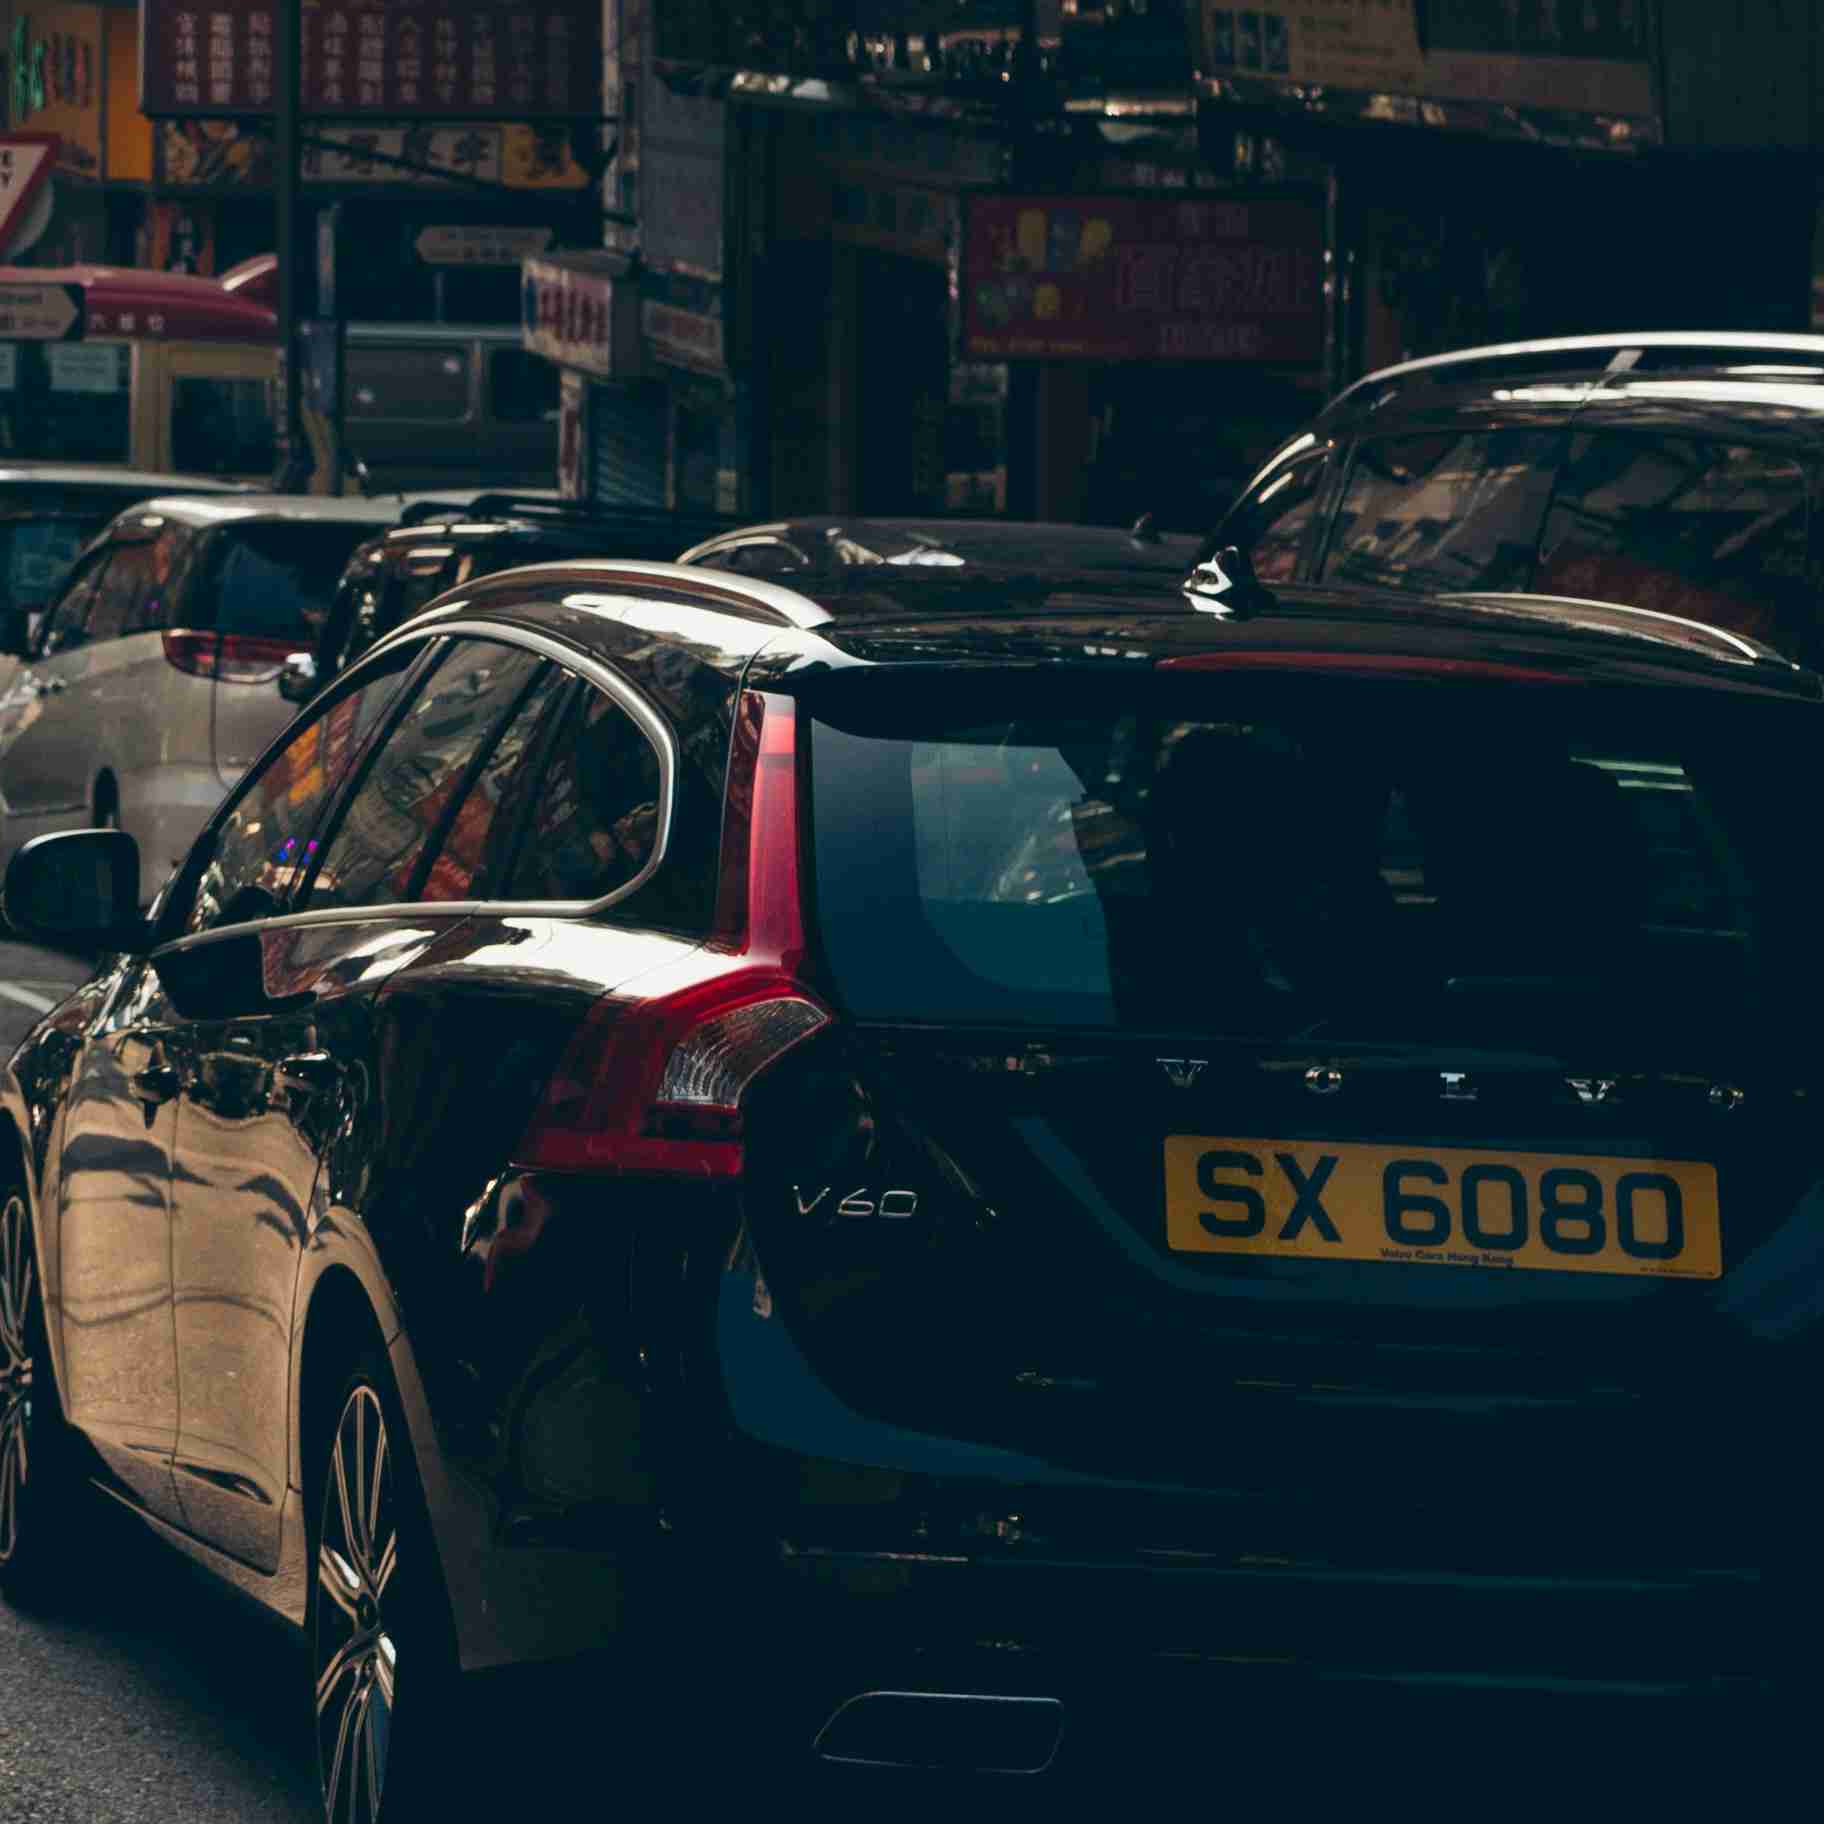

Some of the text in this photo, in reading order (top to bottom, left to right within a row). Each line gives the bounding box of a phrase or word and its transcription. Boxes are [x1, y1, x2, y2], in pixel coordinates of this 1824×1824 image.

[792, 1183, 920, 1220] V60
[1194, 1147, 1685, 1262] SX 6080
